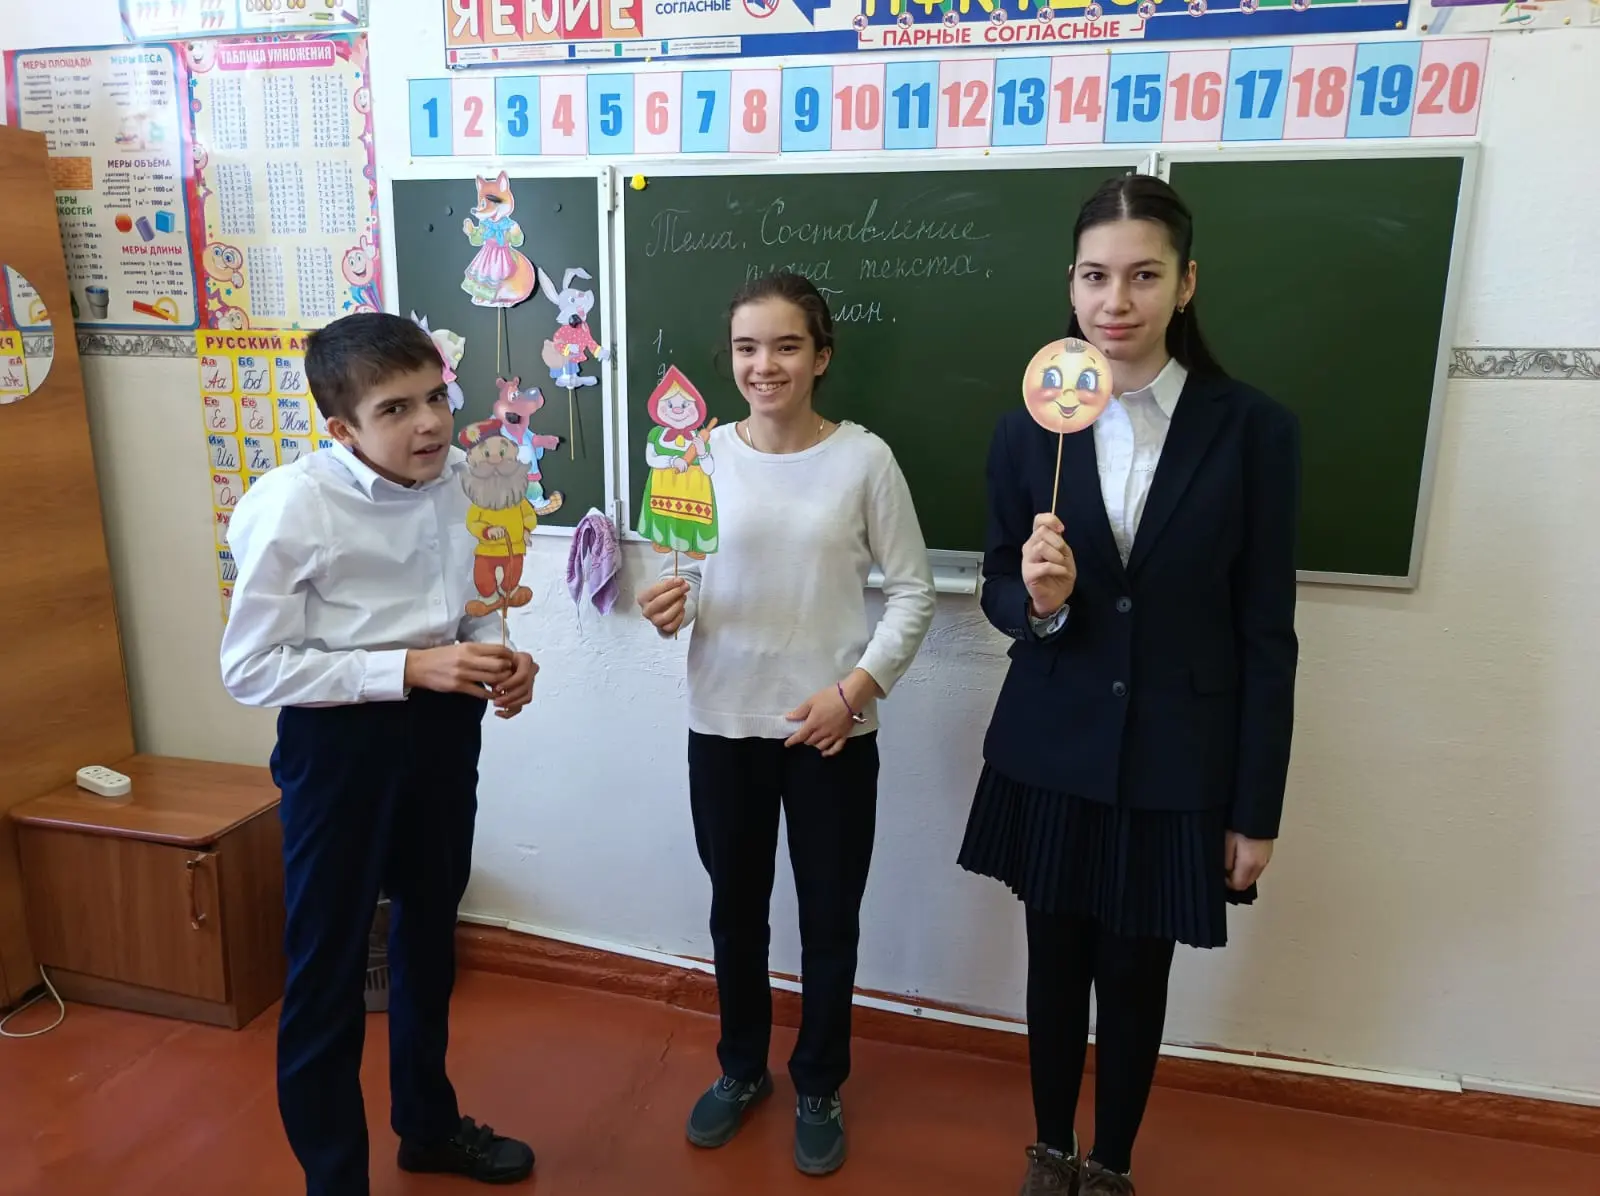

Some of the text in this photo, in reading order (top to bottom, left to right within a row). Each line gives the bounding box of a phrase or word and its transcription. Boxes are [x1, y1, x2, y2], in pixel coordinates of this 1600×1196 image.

[655, 0, 732, 15] СОГЛАСНЫЕ
[883, 21, 1120, 47] ПАРНЫЕ СОГЛАСНЫЕ
[23, 59, 47, 69] МЕРЫ
[221, 45, 332, 66] ТАБЛИЦА УМНОЖЕНИЯ
[423, 62, 1480, 138] 1 2 3 4 5 6 7 8 9 10 11 12 13 14 15 16 17 18 19 20
[108, 160, 132, 168] МЕРЫ
[56, 205, 92, 216] КОСТЕЙ
[645, 197, 992, 258] Тема. Составление
[122, 246, 183, 256] МЕРЫ ДЛИНЫ
[860, 253, 993, 280] текста.
[206, 336, 282, 350] РУССКИЙ
[652, 328, 673, 354] 1.
[238, 357, 254, 367] Бб
[276, 358, 290, 367] Вв
[205, 370, 302, 390] Аа Бб Вв
[278, 398, 300, 408] Жж
[212, 409, 226, 429] Ее
[280, 412, 308, 431] Жж
[244, 437, 260, 447] Кк
[252, 450, 270, 469] Кк
[220, 487, 237, 506] Оо
